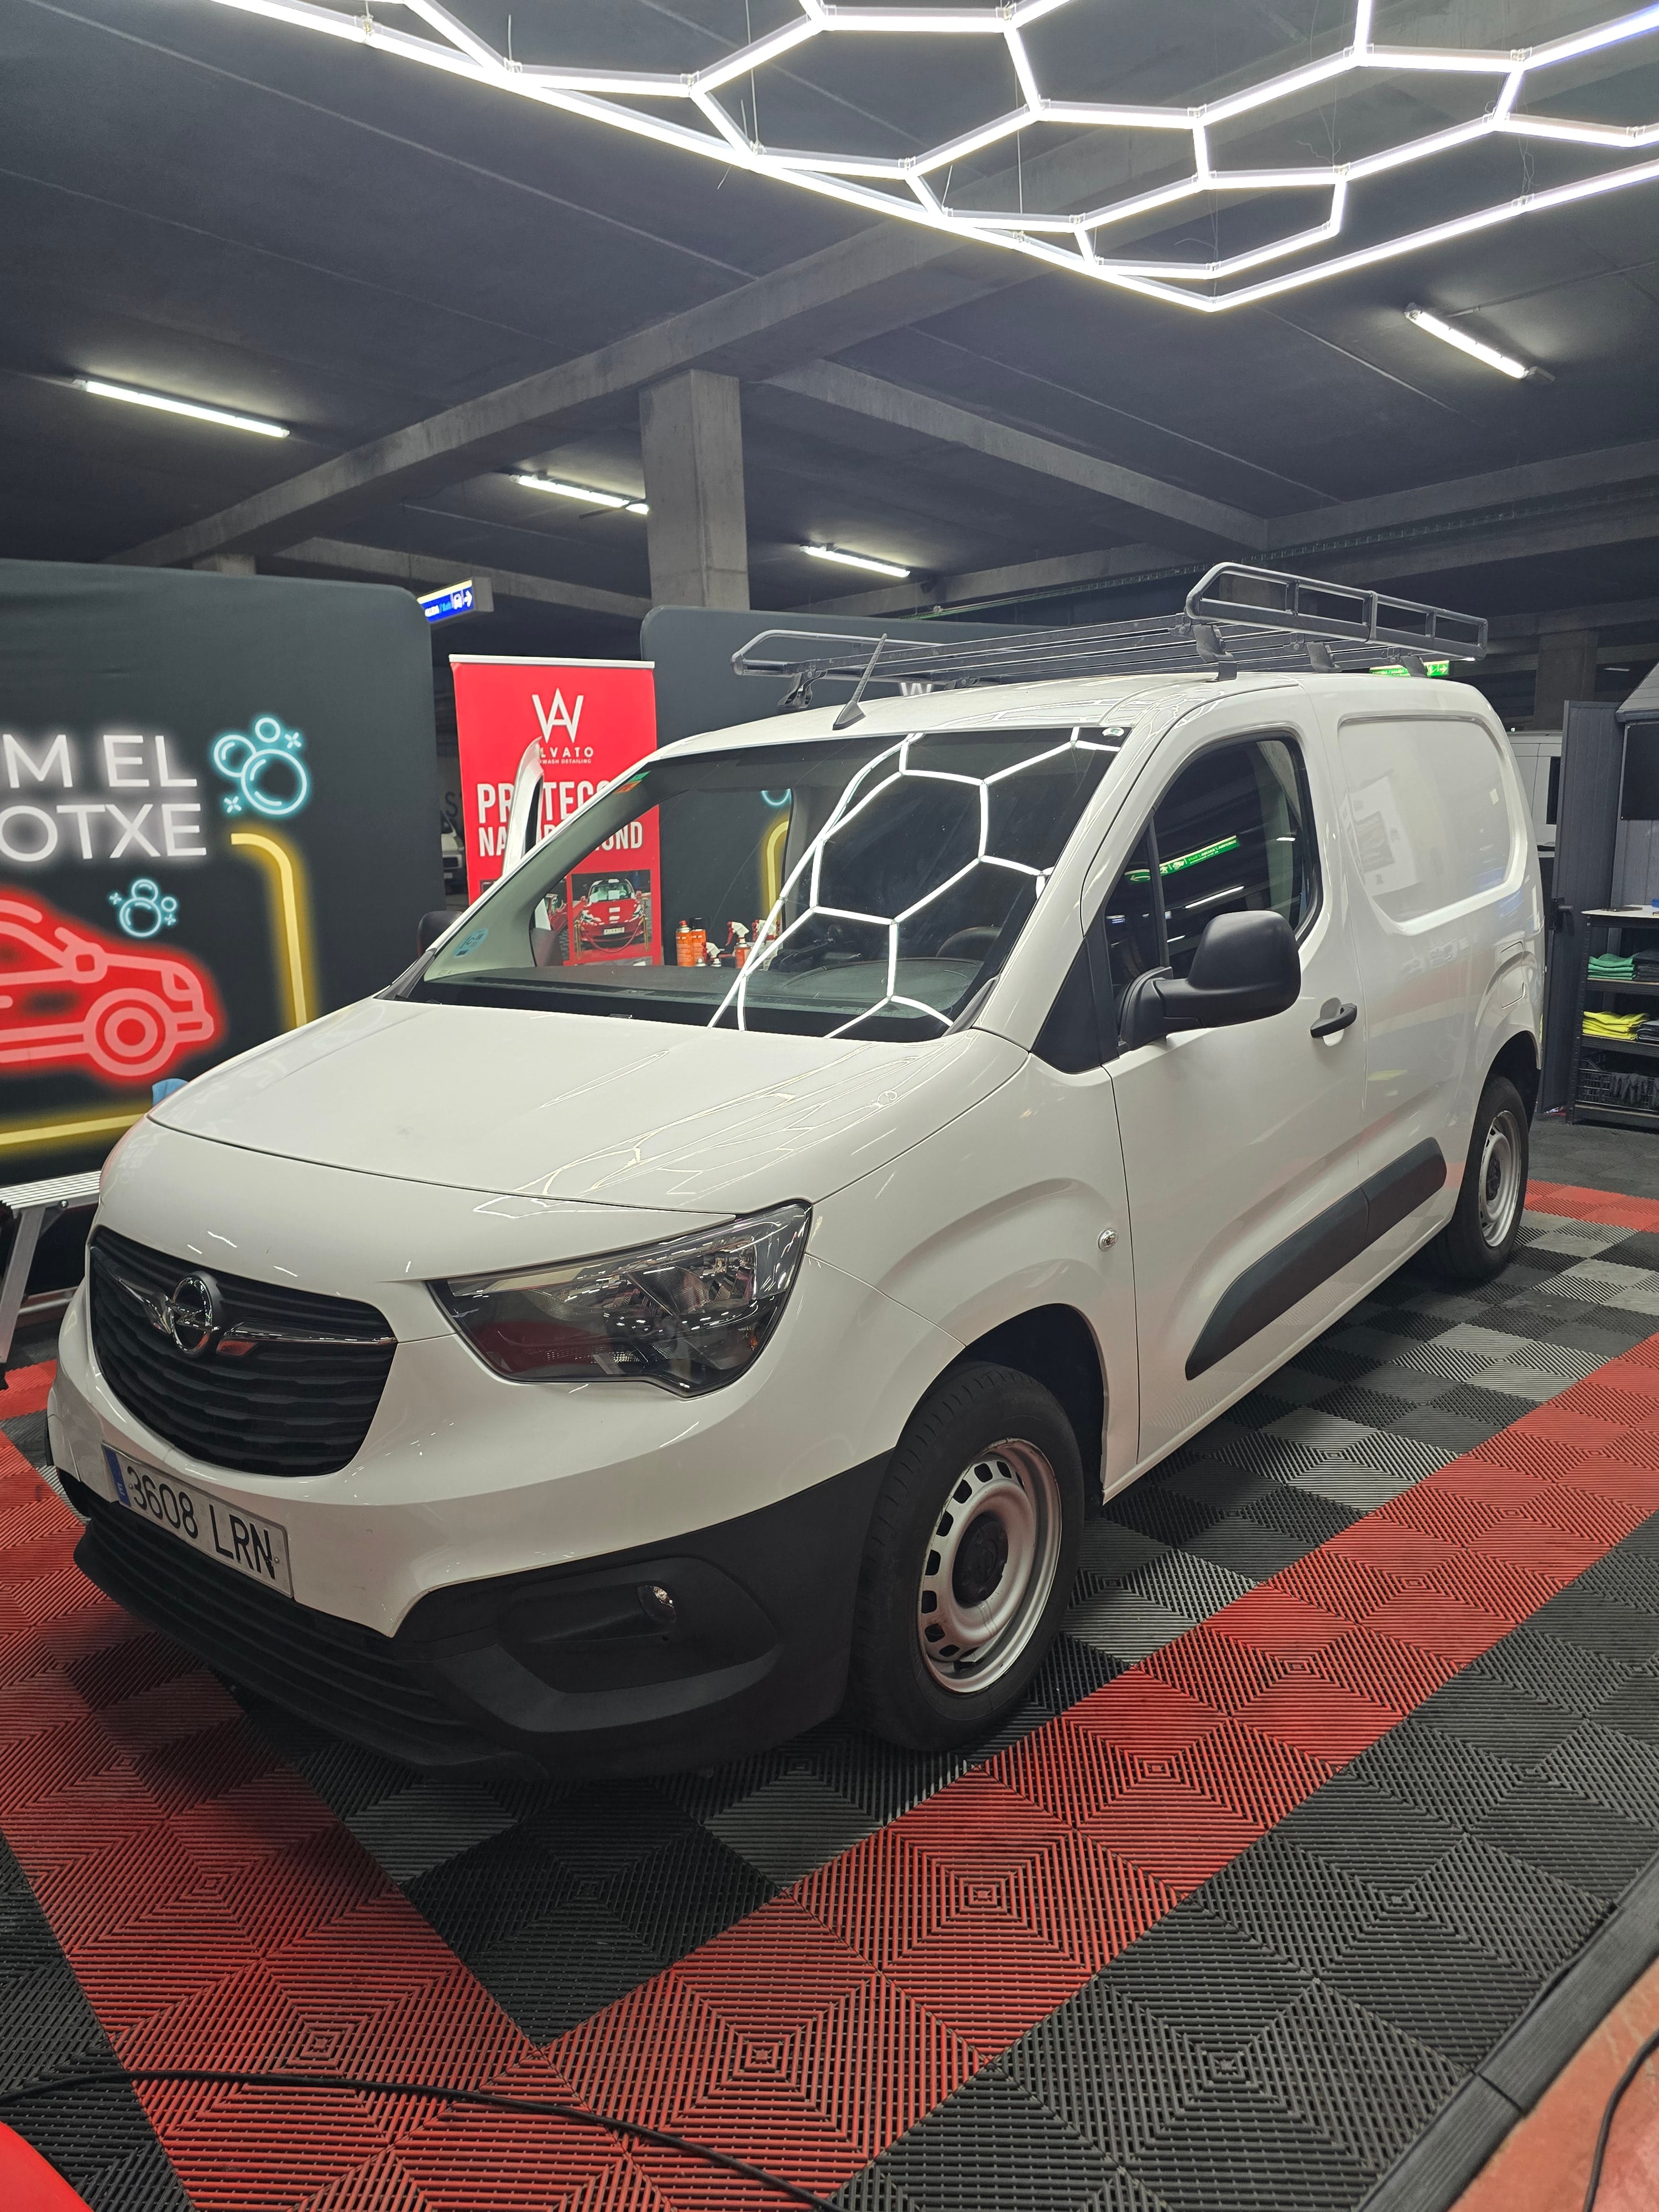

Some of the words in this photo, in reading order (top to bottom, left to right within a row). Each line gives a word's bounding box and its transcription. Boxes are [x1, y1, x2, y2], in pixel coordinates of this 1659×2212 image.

[103, 735, 197, 787] EL
[540, 747, 594, 758] LVATO
[477, 780, 611, 823] PRTEC
[0, 804, 207, 862] OTXE
[127, 1465, 199, 1539] 3608
[209, 1504, 276, 1580] LRN
